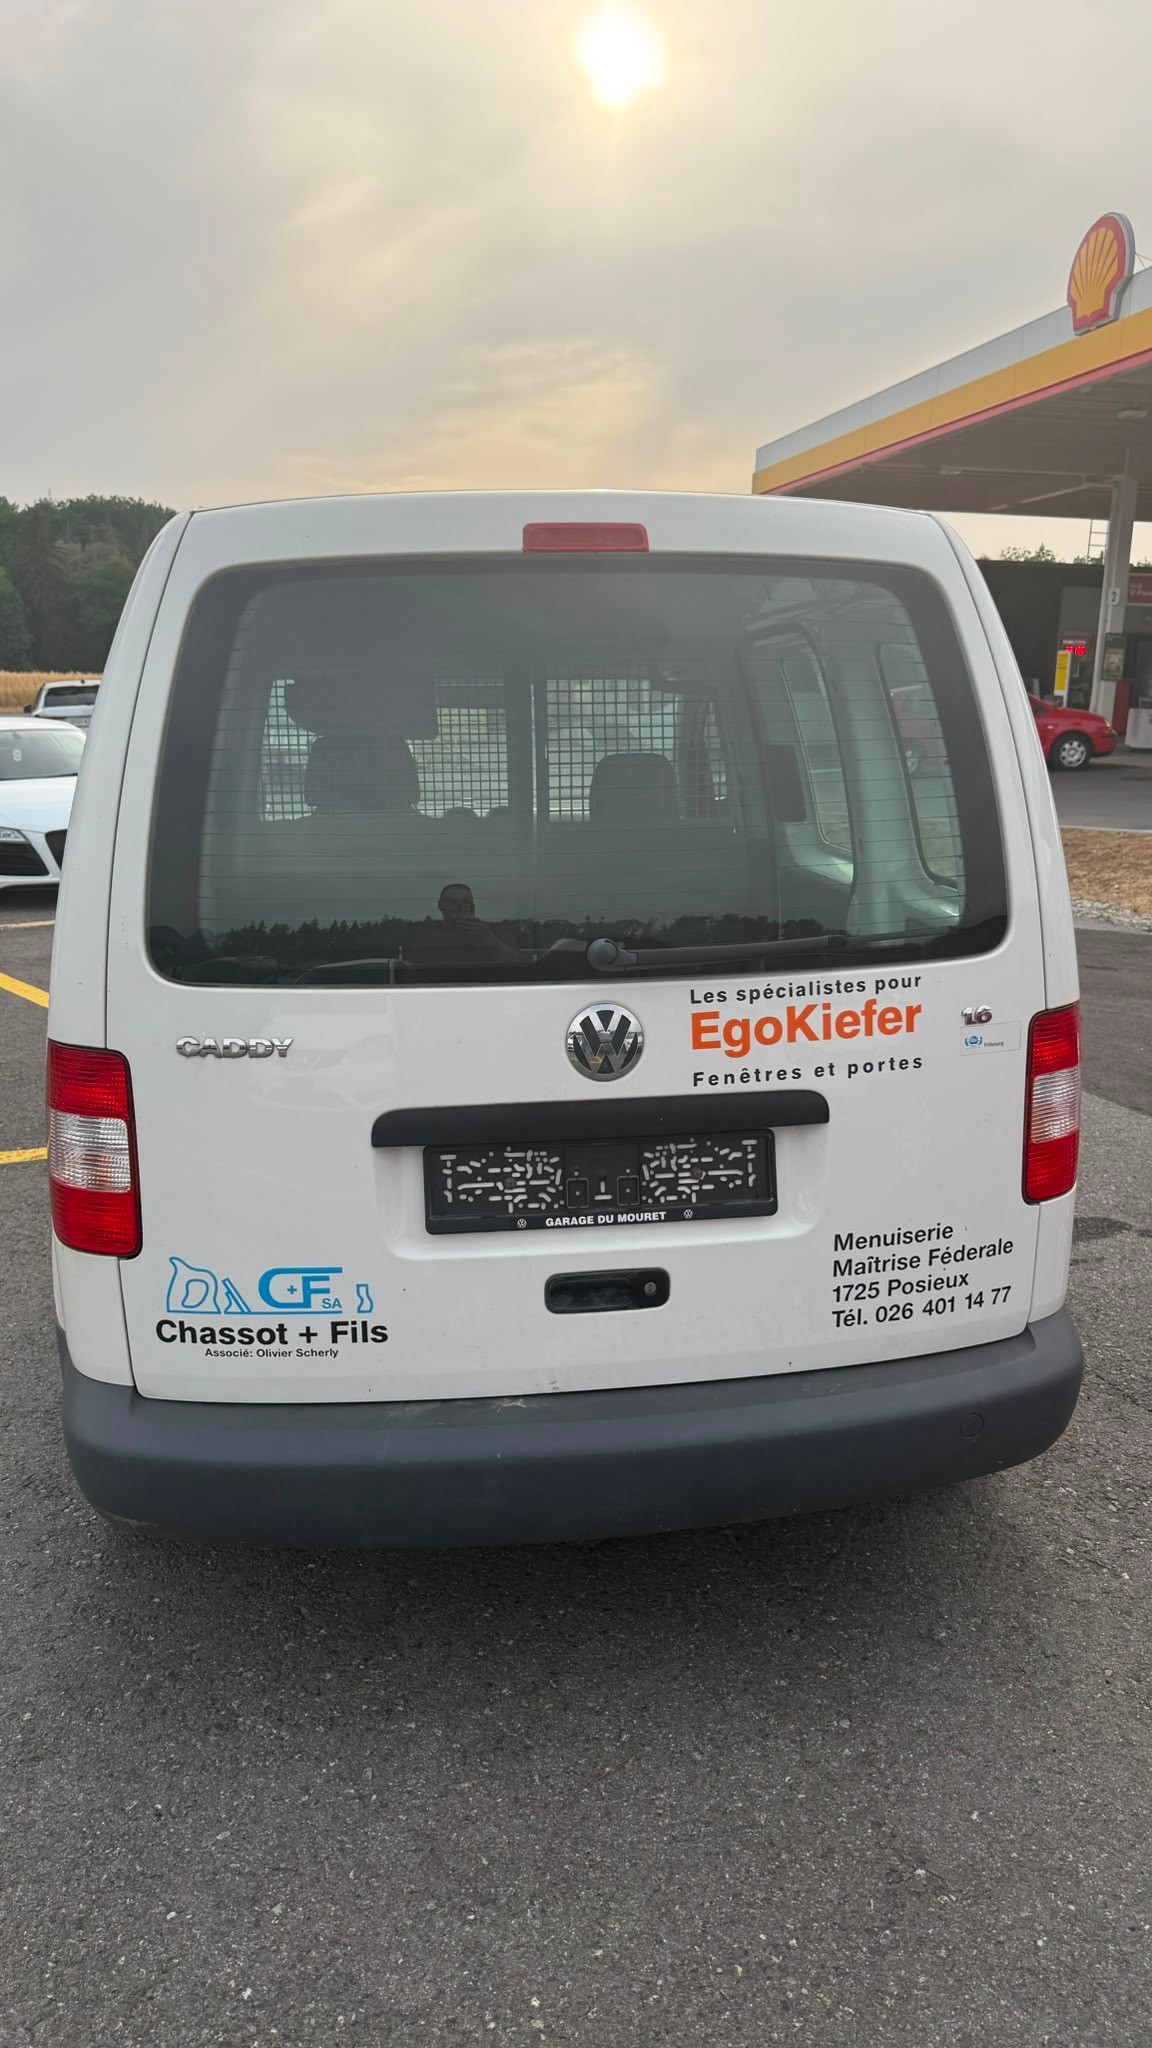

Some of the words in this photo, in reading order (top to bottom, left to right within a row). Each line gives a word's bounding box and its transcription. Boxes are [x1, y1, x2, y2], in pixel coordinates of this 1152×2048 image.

[1111, 591, 1117, 602] 2
[690, 988, 728, 1005] Les
[735, 979, 866, 1005] spécialistes
[874, 976, 922, 995] pour
[691, 998, 922, 1059] EgoKiefer
[176, 1035, 294, 1059] CADDY
[693, 1067, 802, 1088] Fenêtres
[814, 1062, 835, 1079] et
[847, 1057, 923, 1079] portes
[545, 1215, 595, 1227] GARAGE
[597, 1214, 614, 1224] DU
[617, 1211, 667, 1222] MOURET
[833, 1223, 954, 1252] Menuiserie
[832, 1255, 921, 1278] Maîtrise
[928, 1237, 1014, 1267] Féderale
[832, 1281, 880, 1303] 1725
[887, 1273, 969, 1297] Posieux
[321, 1298, 342, 1309] SA
[831, 1308, 868, 1328] Tél.
[875, 1303, 914, 1323] 026
[922, 1296, 956, 1317] 401
[964, 1291, 985, 1310] 14
[991, 1286, 1012, 1305] 77
[155, 1319, 289, 1346] Chassot
[299, 1325, 319, 1344] +
[330, 1320, 389, 1344] Fils
[204, 1347, 253, 1358] Associé:
[256, 1348, 293, 1358] Olivier
[295, 1347, 340, 1359] Scherly
